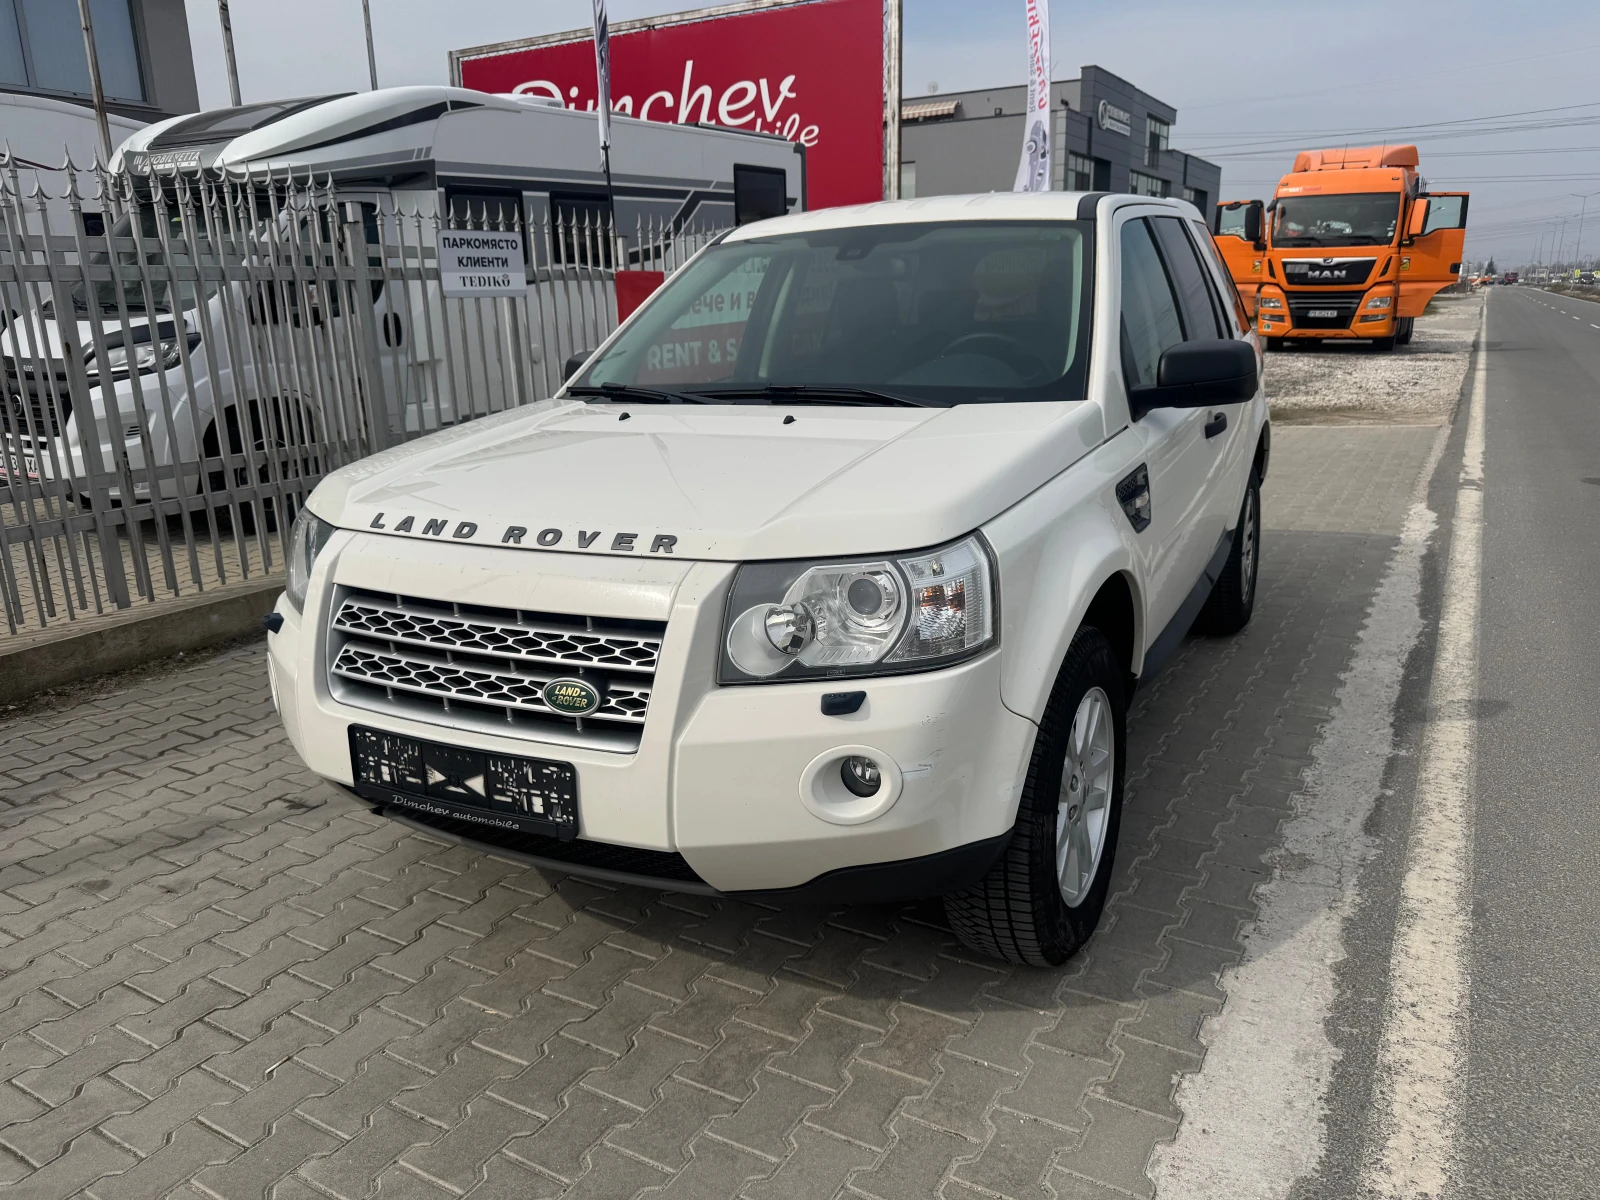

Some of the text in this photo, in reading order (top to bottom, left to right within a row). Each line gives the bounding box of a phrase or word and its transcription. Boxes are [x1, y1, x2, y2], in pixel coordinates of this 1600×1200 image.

[442, 237, 518, 250] ПАРКОМЯСТО
[457, 256, 509, 268] КЛИЕНТИ
[1307, 270, 1347, 279] MAN
[459, 275, 511, 288] TEDIKO
[647, 341, 702, 371] RENT
[708, 340, 721, 364] &
[369, 512, 678, 554] LAND ROVER
[554, 685, 581, 697] LAND
[556, 695, 588, 708] ROVER
[392, 794, 520, 830] Dimchev automobile
